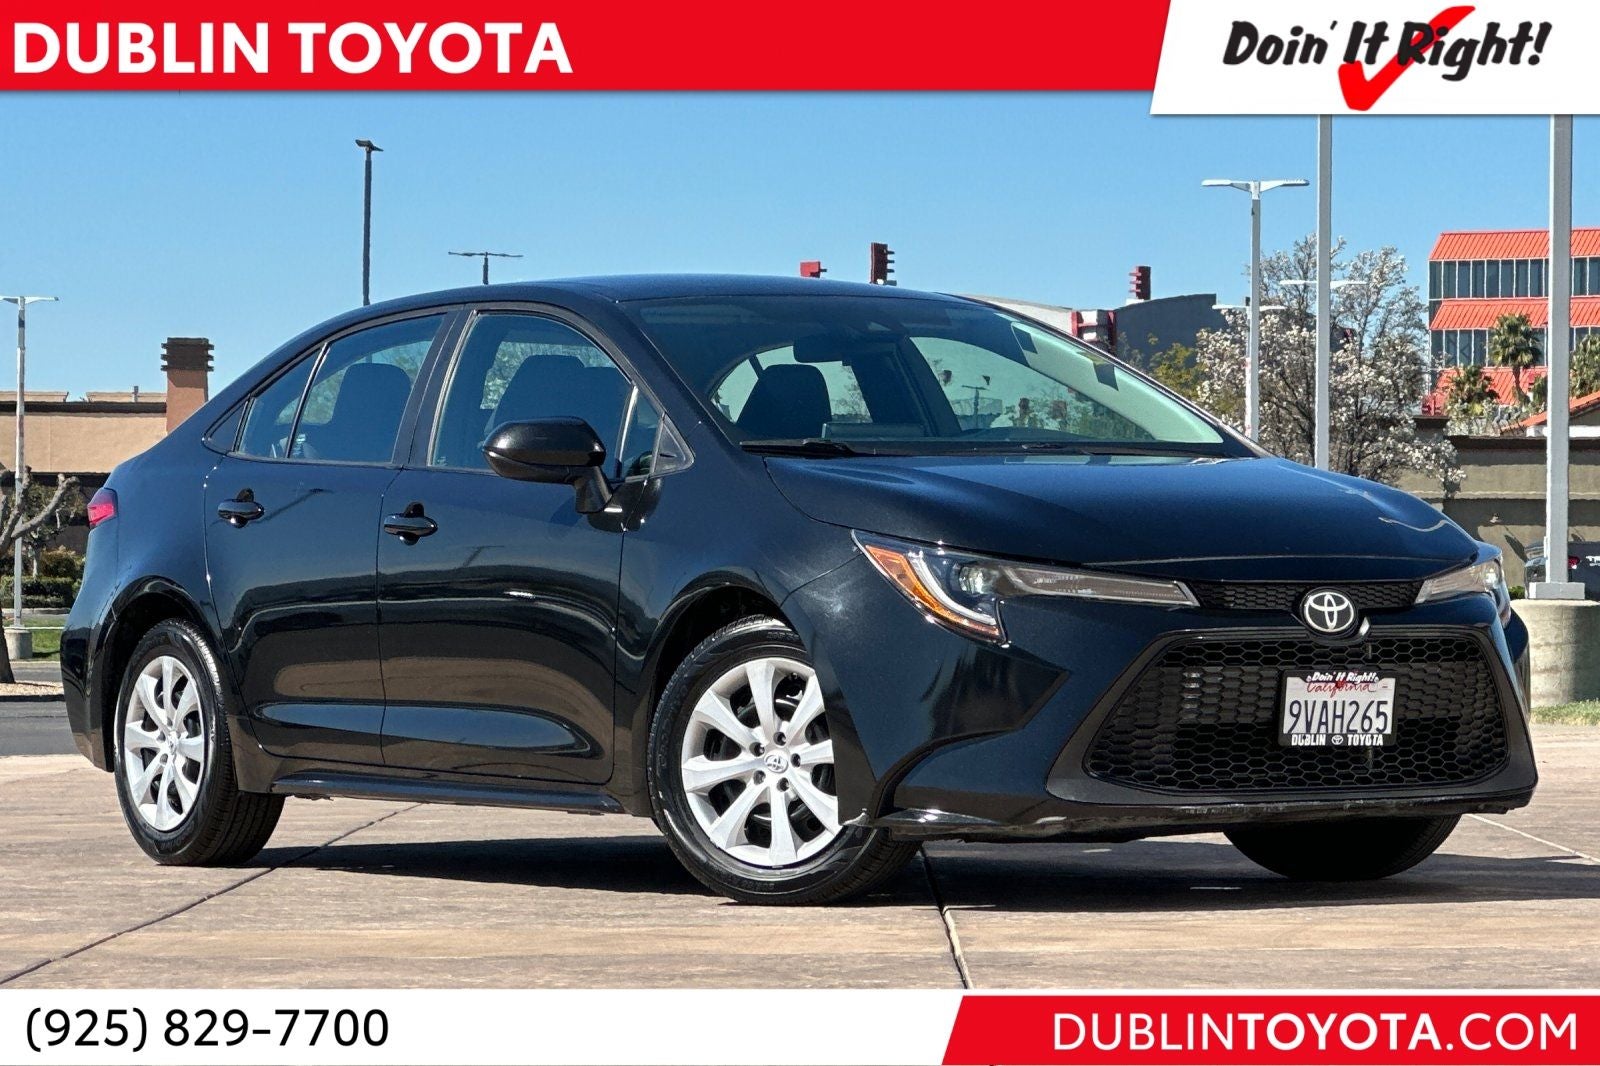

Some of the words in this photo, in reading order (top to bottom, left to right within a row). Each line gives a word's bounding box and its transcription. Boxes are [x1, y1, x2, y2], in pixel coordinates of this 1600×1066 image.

[1335, 671, 1346, 681] It
[1346, 671, 1377, 684] Right!
[1286, 700, 1389, 733] 9VAH265
[1291, 734, 1326, 746] DUBLIN
[1347, 734, 1384, 746] TOYOTA
